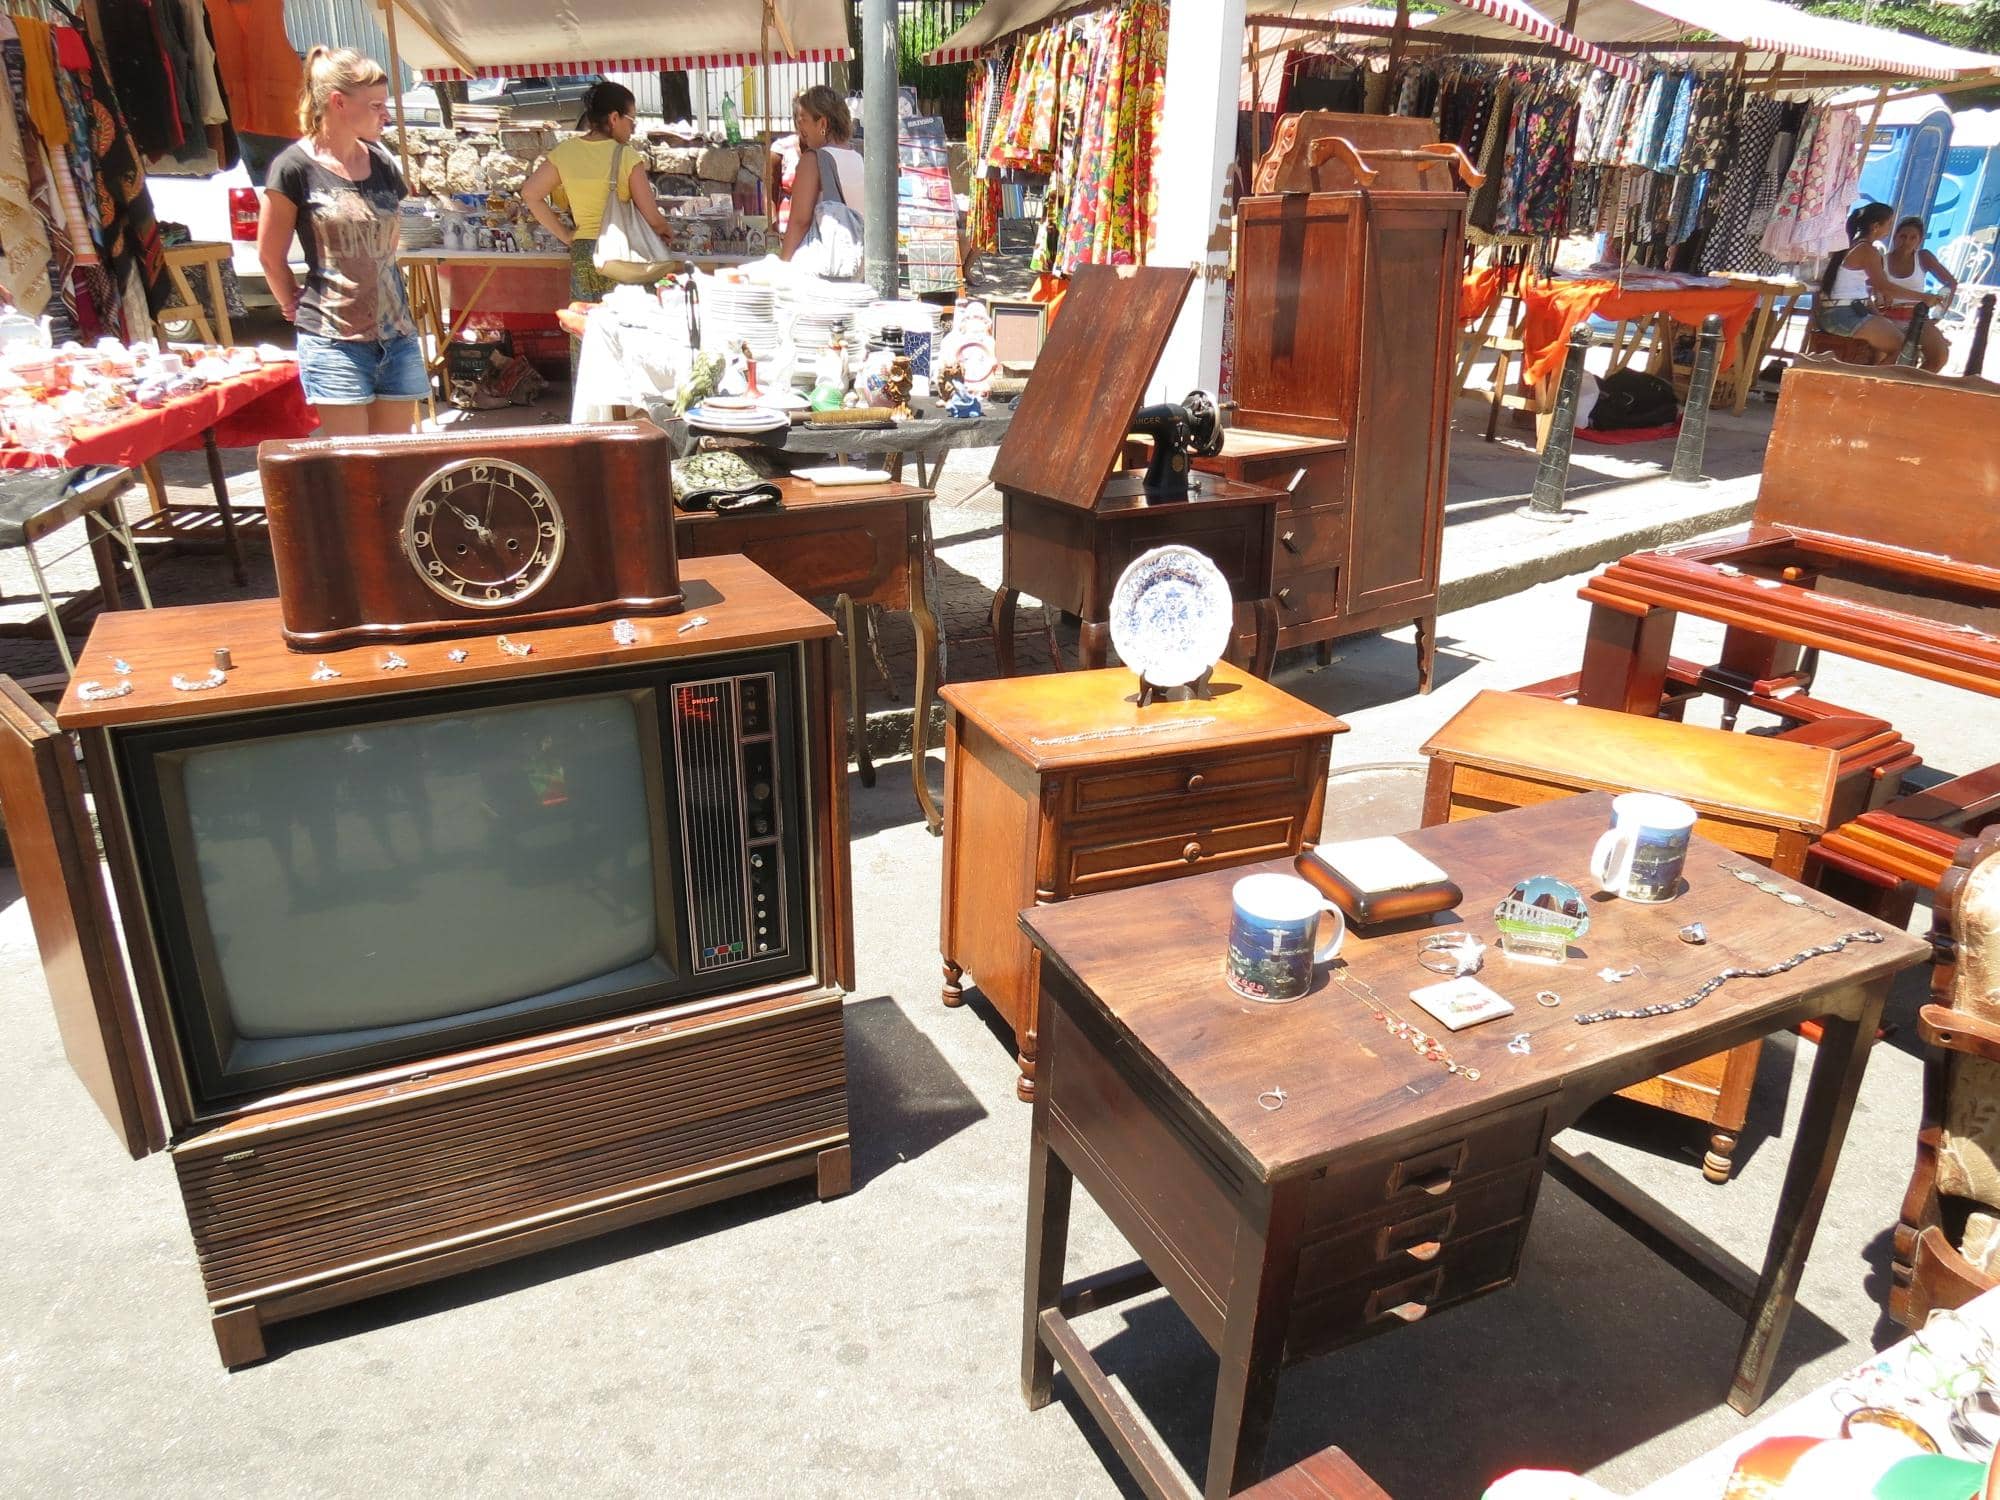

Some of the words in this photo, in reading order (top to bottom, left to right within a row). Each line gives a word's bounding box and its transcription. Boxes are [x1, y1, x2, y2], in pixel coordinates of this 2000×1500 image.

[470, 465, 488, 482] 12
[507, 472, 515, 487] 1
[440, 476, 454, 493] 11
[417, 500, 436, 516] 10
[531, 492, 544, 508] 2
[540, 522, 556, 537] 3
[414, 531, 430, 547] 9
[535, 551, 549, 566] 4
[428, 560, 444, 576] 8
[451, 580, 466, 595] 7
[516, 573, 529, 590] 5
[485, 585, 500, 600] 6
